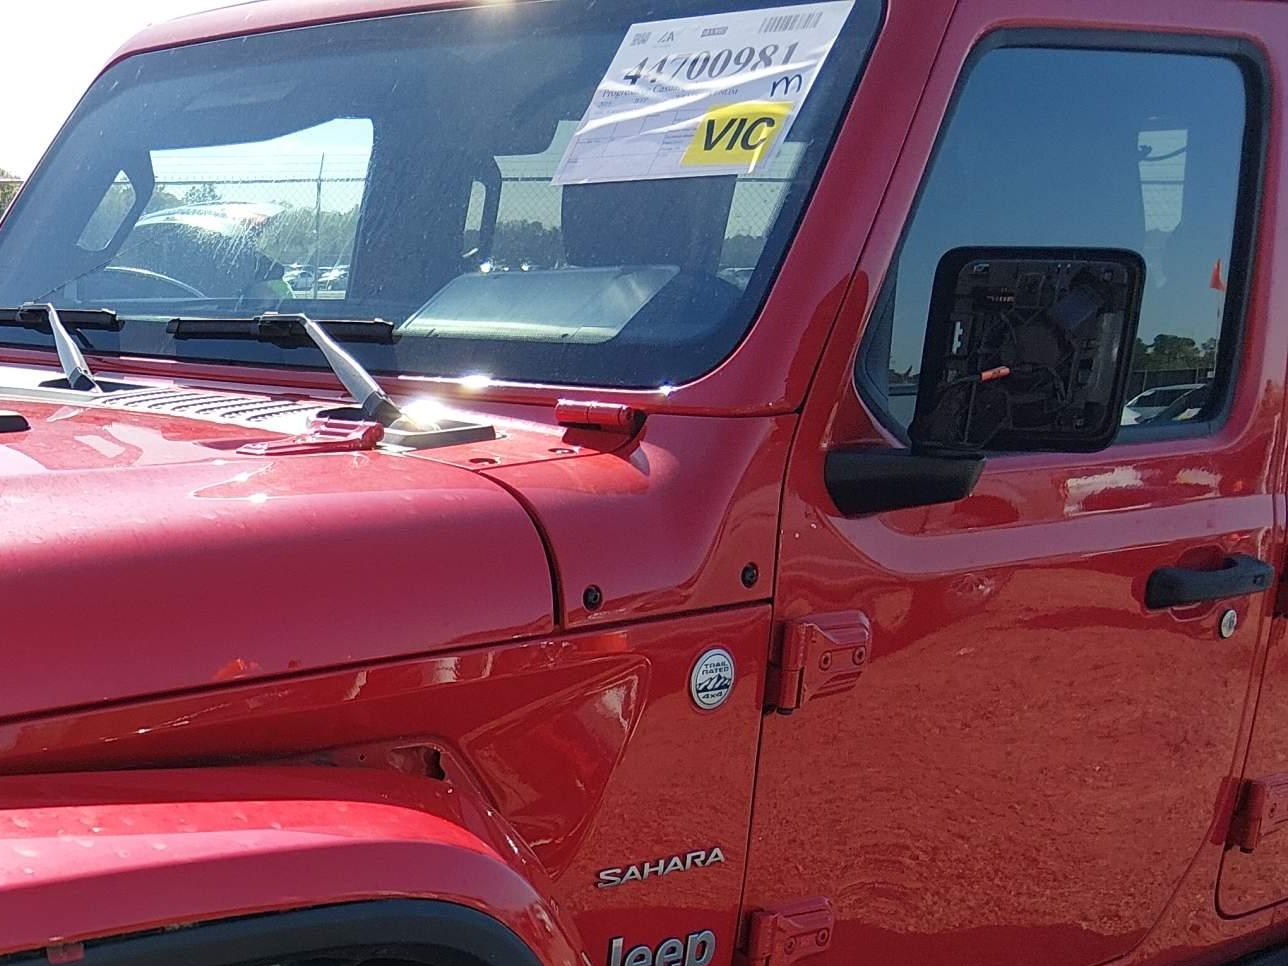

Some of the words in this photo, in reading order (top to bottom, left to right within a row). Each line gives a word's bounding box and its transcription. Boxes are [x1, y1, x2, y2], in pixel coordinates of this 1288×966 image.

[622, 42, 800, 86] 44700981
[702, 116, 775, 152] VIC
[702, 666, 730, 675] RATED
[704, 660, 729, 669] TRAIL
[596, 846, 726, 889] SAHARA
